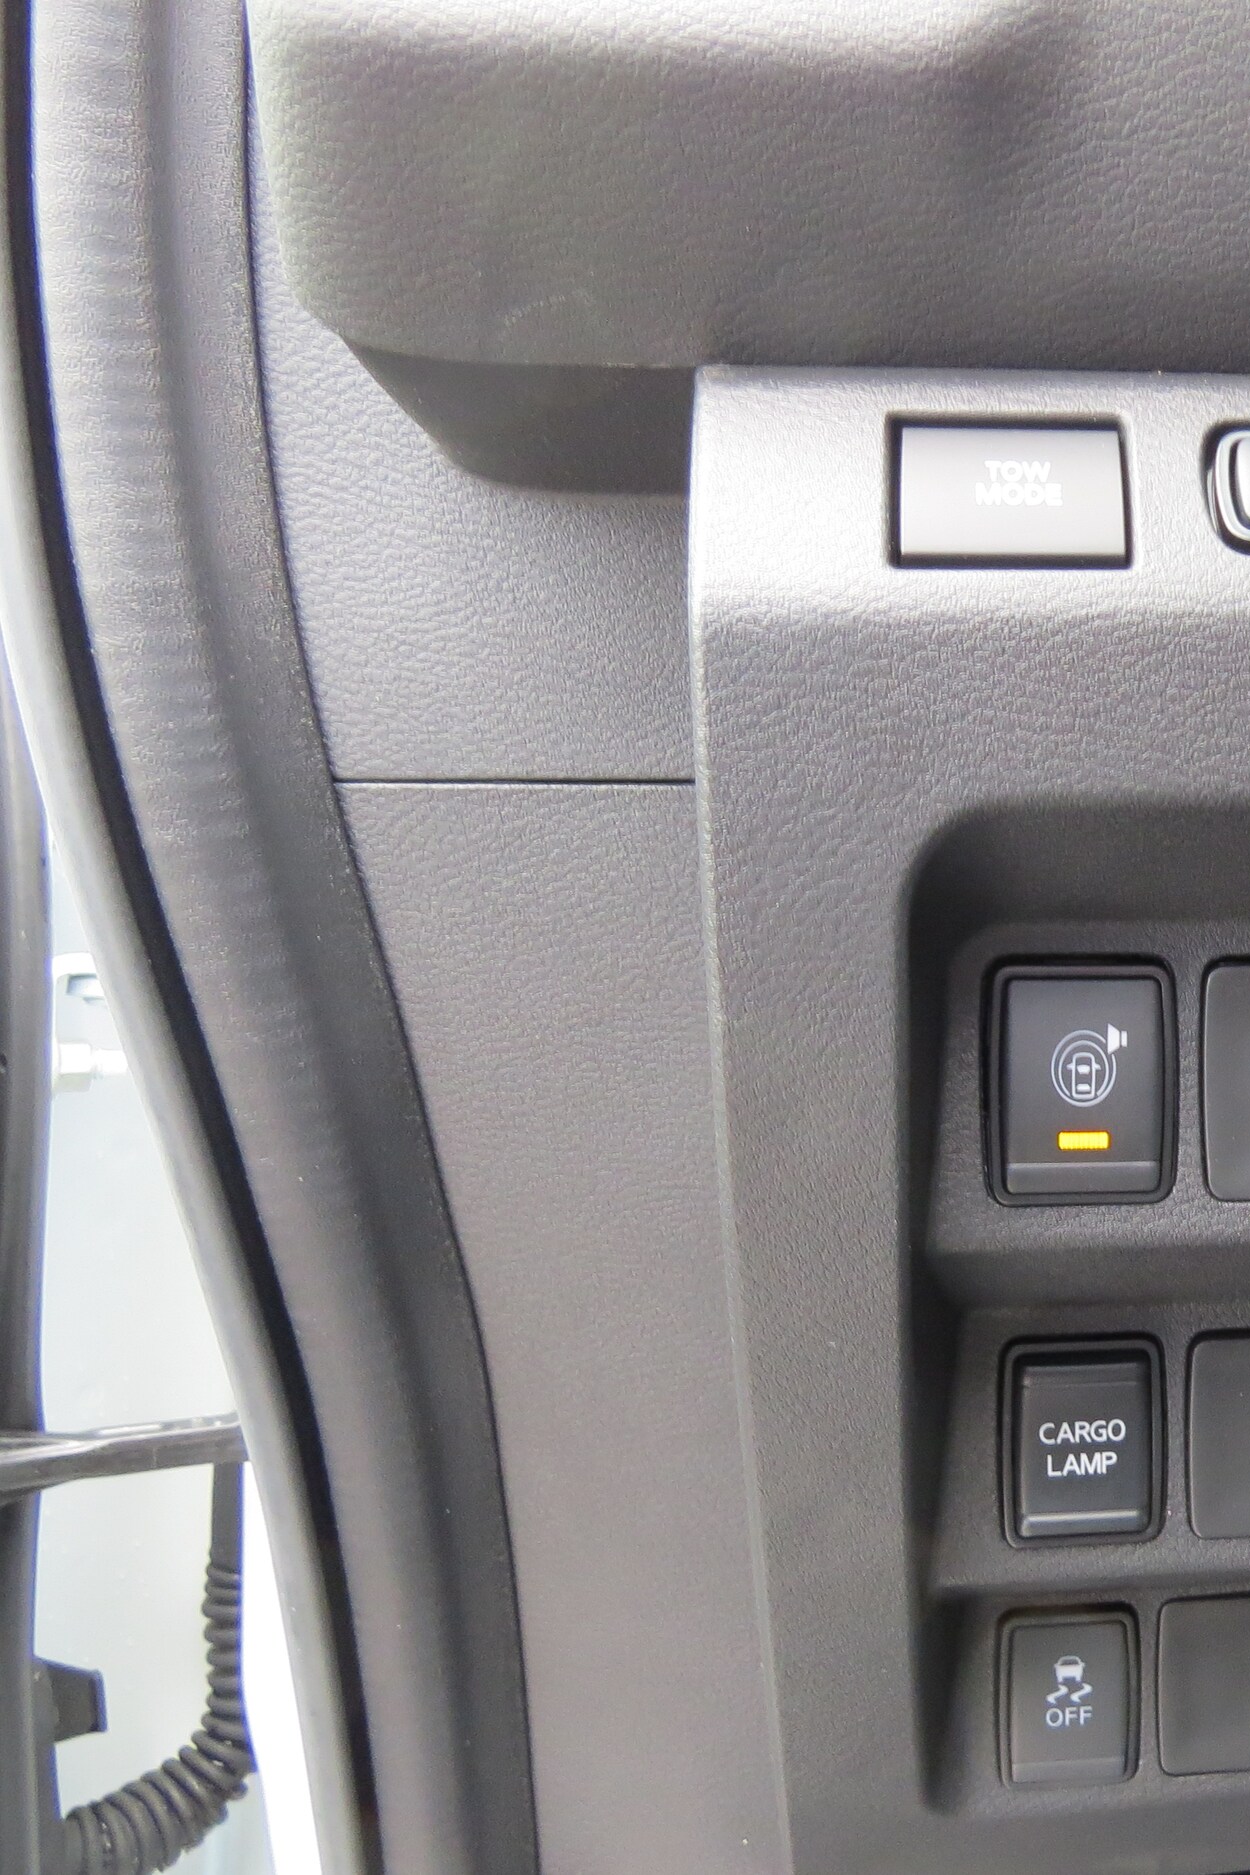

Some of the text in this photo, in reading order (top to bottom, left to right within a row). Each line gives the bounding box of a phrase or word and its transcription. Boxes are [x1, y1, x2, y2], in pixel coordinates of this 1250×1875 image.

[984, 461, 1051, 482] TOW
[975, 482, 1063, 506] MODE
[1039, 1419, 1126, 1445] CARGO
[1046, 1451, 1117, 1477] LAMP
[1046, 1706, 1093, 1727] OFF
